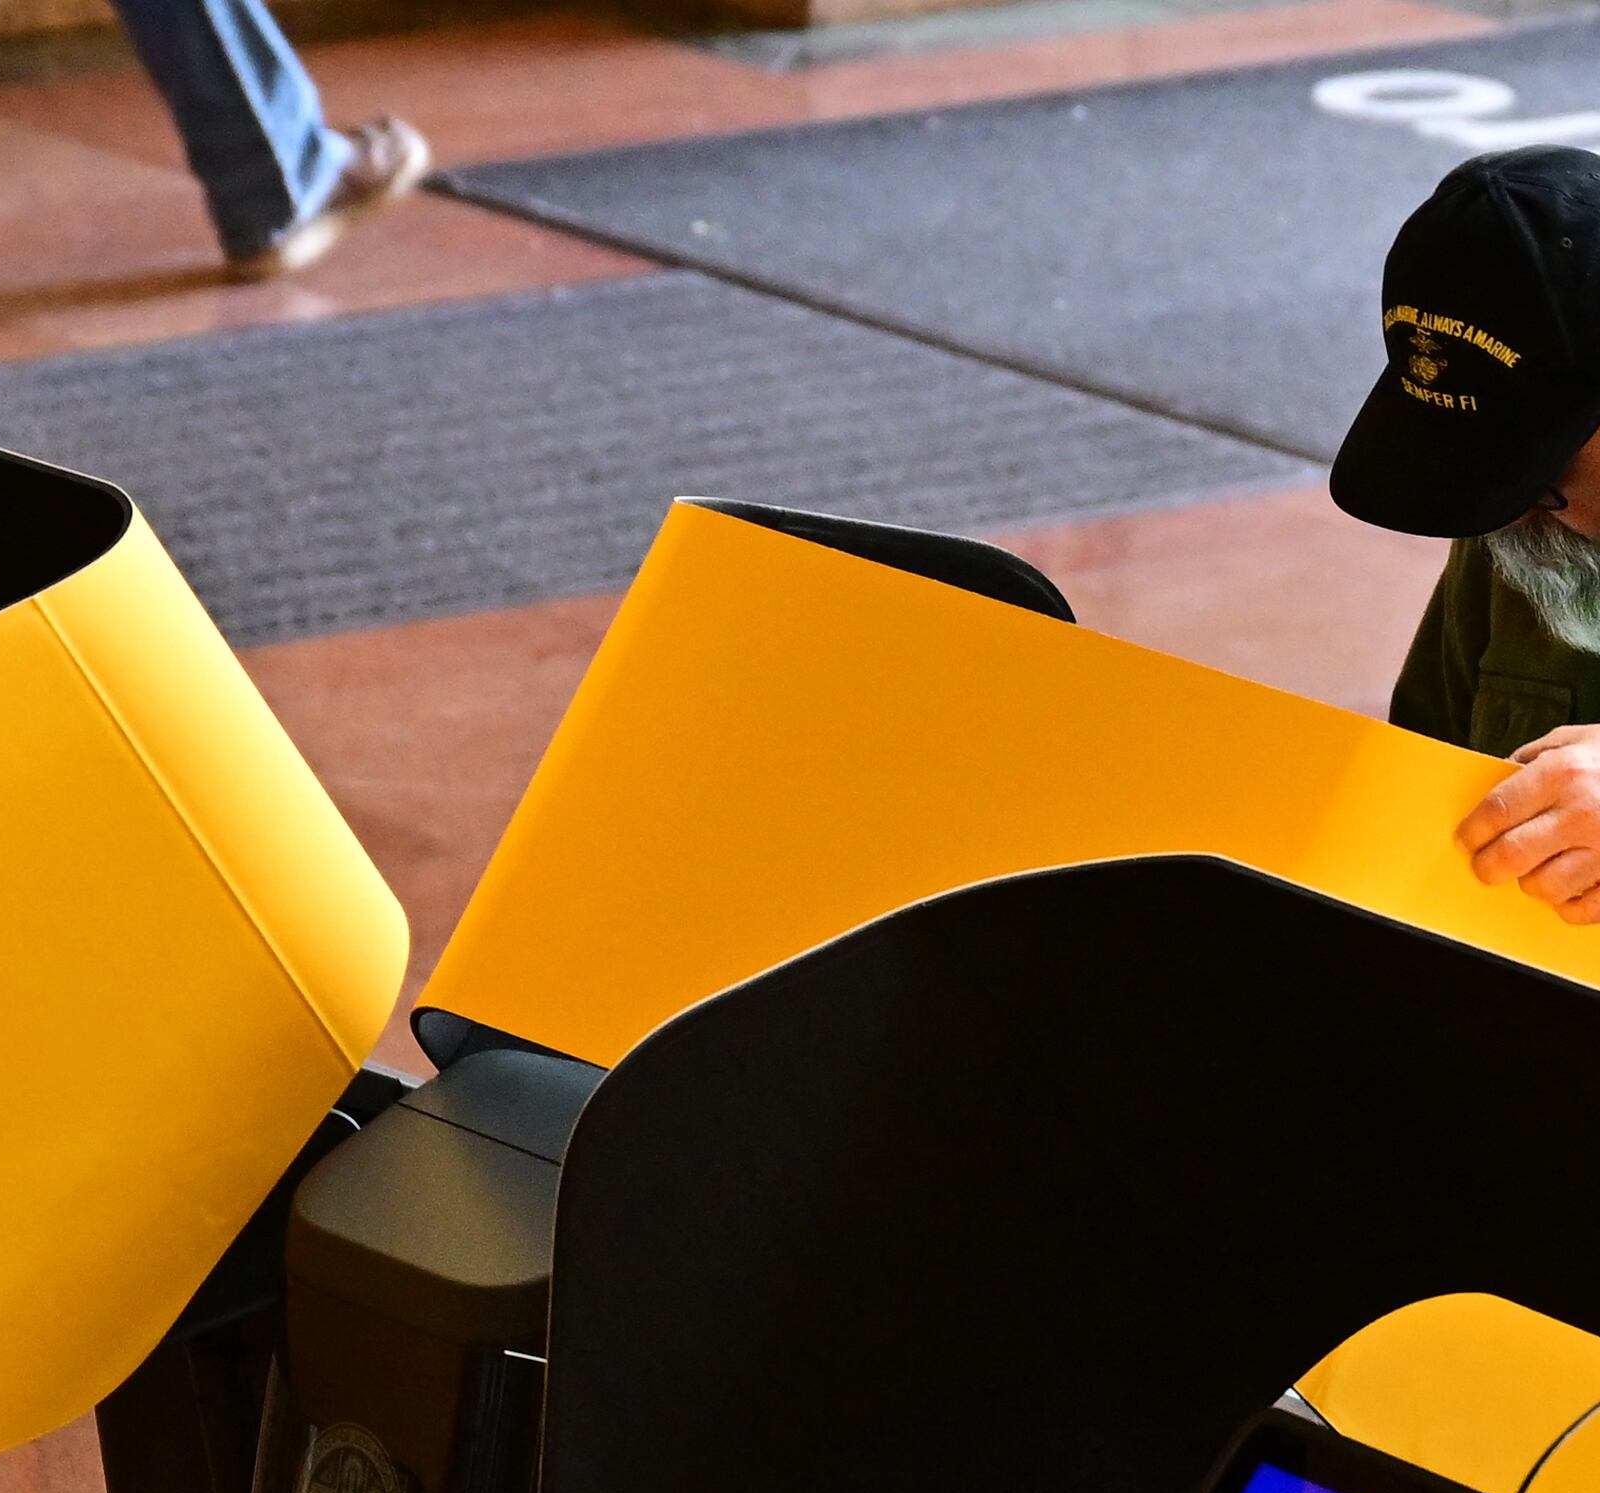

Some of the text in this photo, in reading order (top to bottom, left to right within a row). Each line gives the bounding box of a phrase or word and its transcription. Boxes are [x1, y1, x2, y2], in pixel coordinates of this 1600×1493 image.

[1420, 311, 1465, 337] ALWAYS
[1463, 325, 1475, 343] A
[1473, 329, 1522, 369] MARINE
[1401, 376, 1478, 412] SEMPER FI
